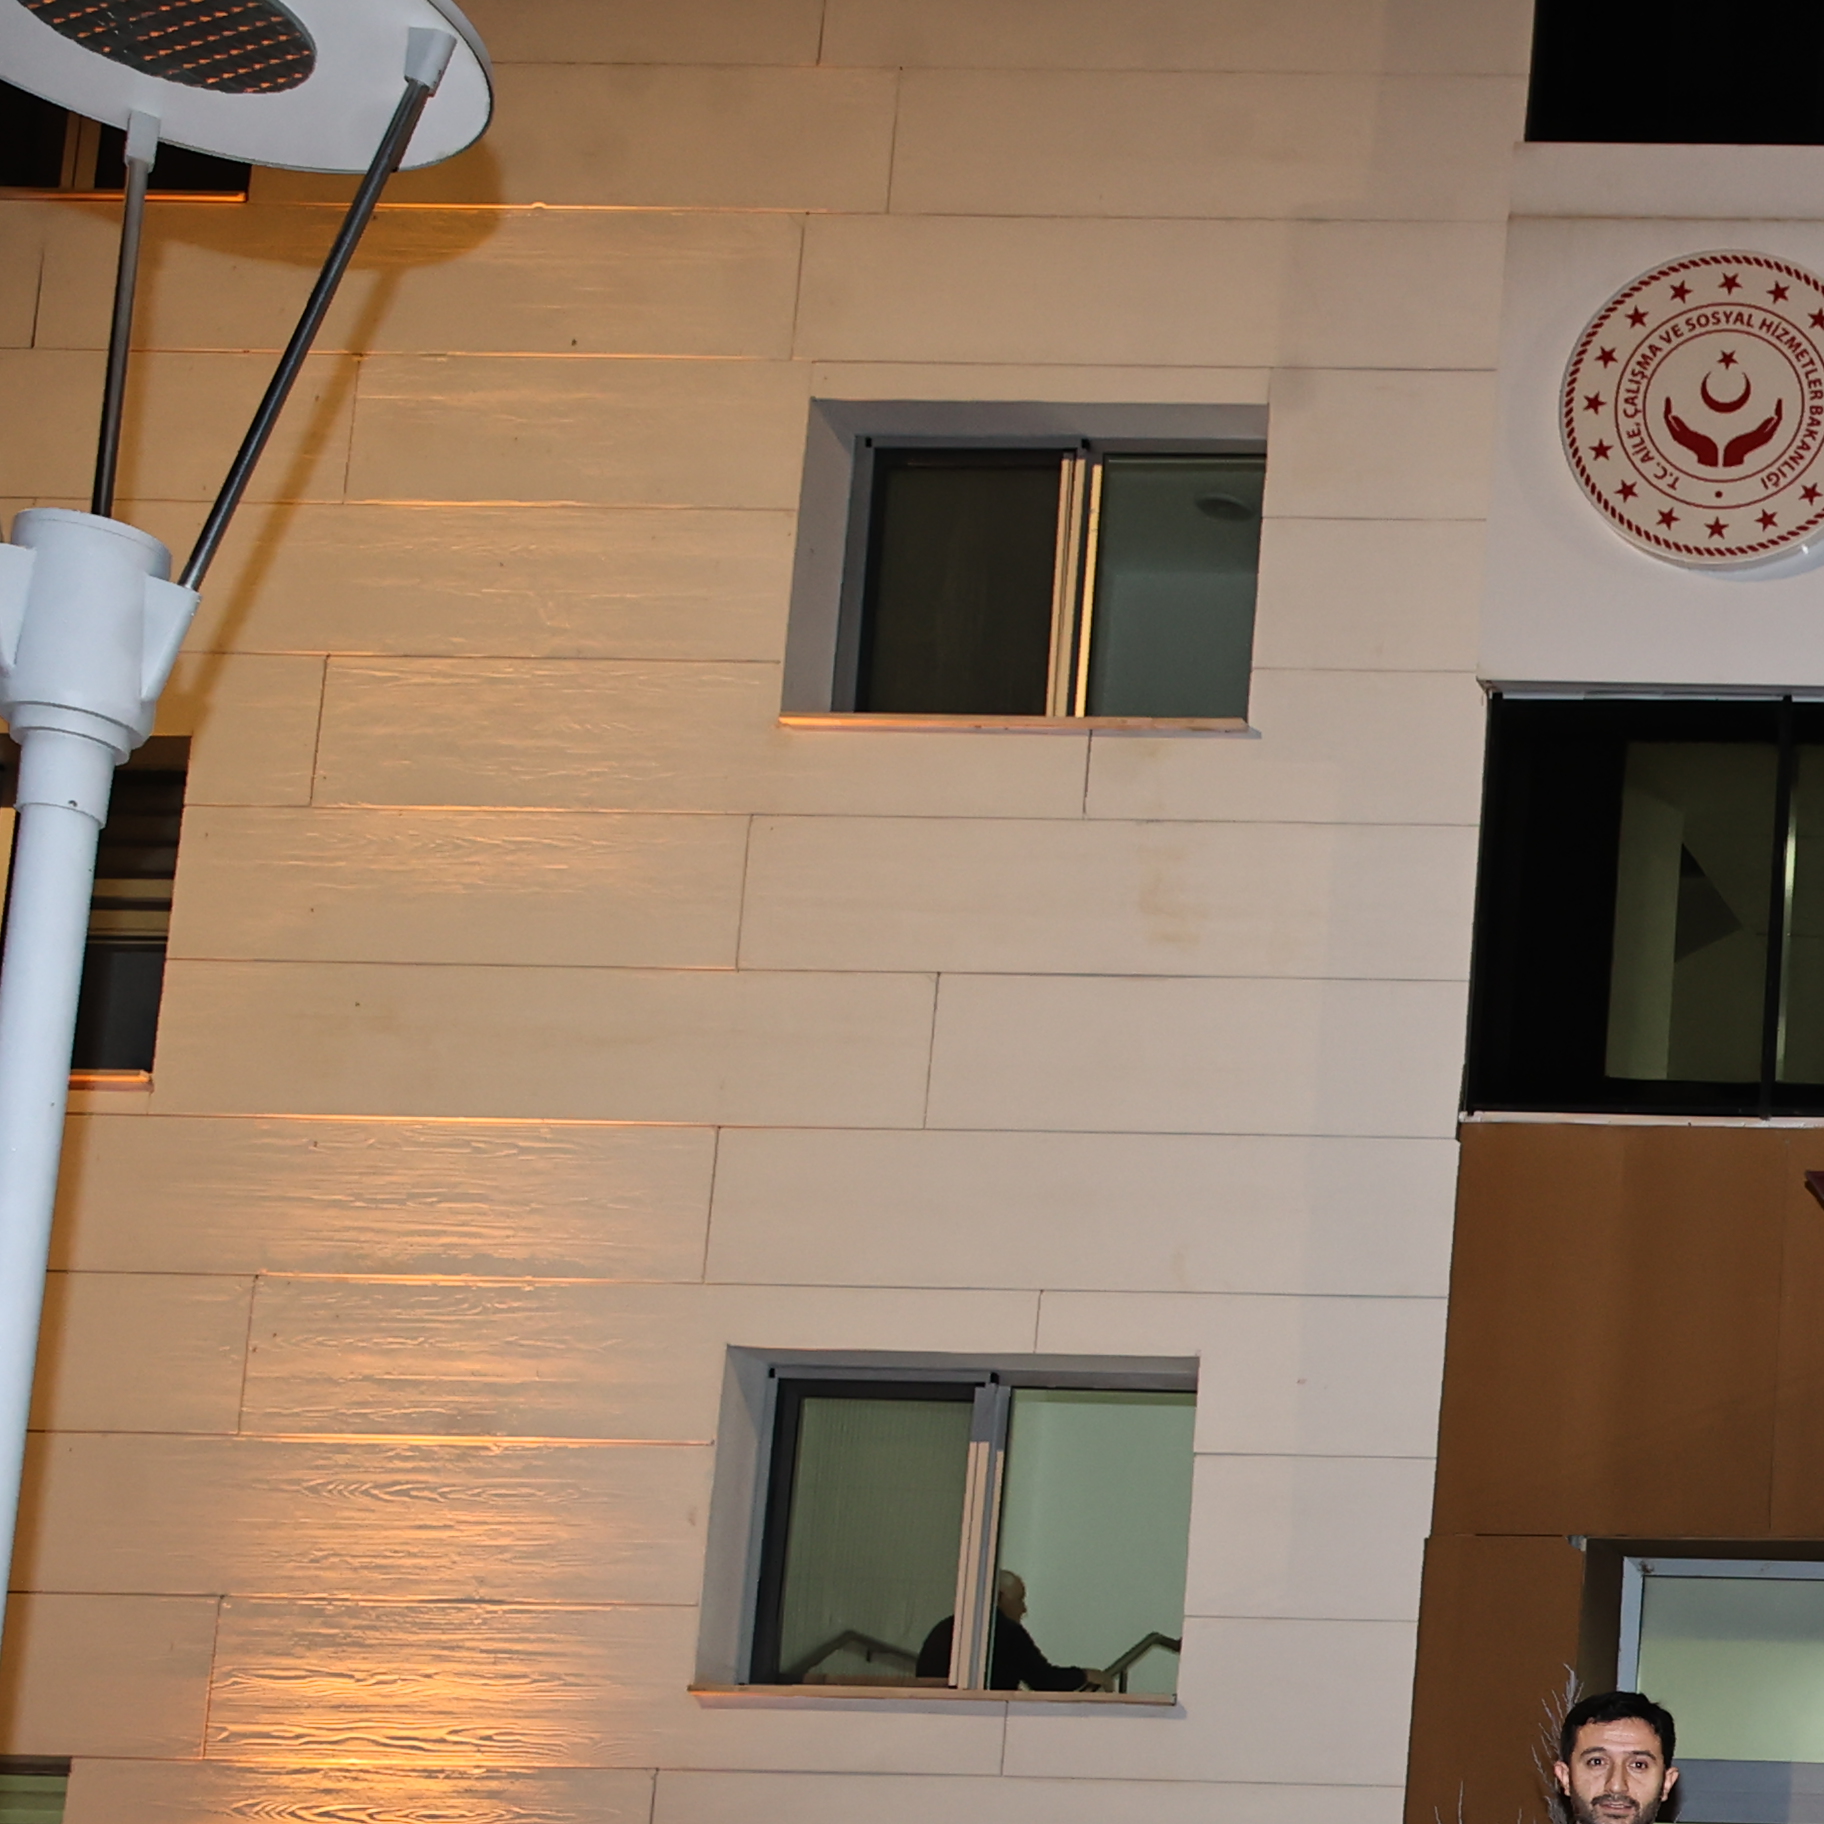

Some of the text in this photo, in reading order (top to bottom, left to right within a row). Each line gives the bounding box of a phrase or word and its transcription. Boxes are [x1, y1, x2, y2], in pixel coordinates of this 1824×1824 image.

[1623, 311, 1824, 491] T.C. AİLE, ÇALIŞMA VE SOSYAL HİZMETLER BAKANLIĞI
